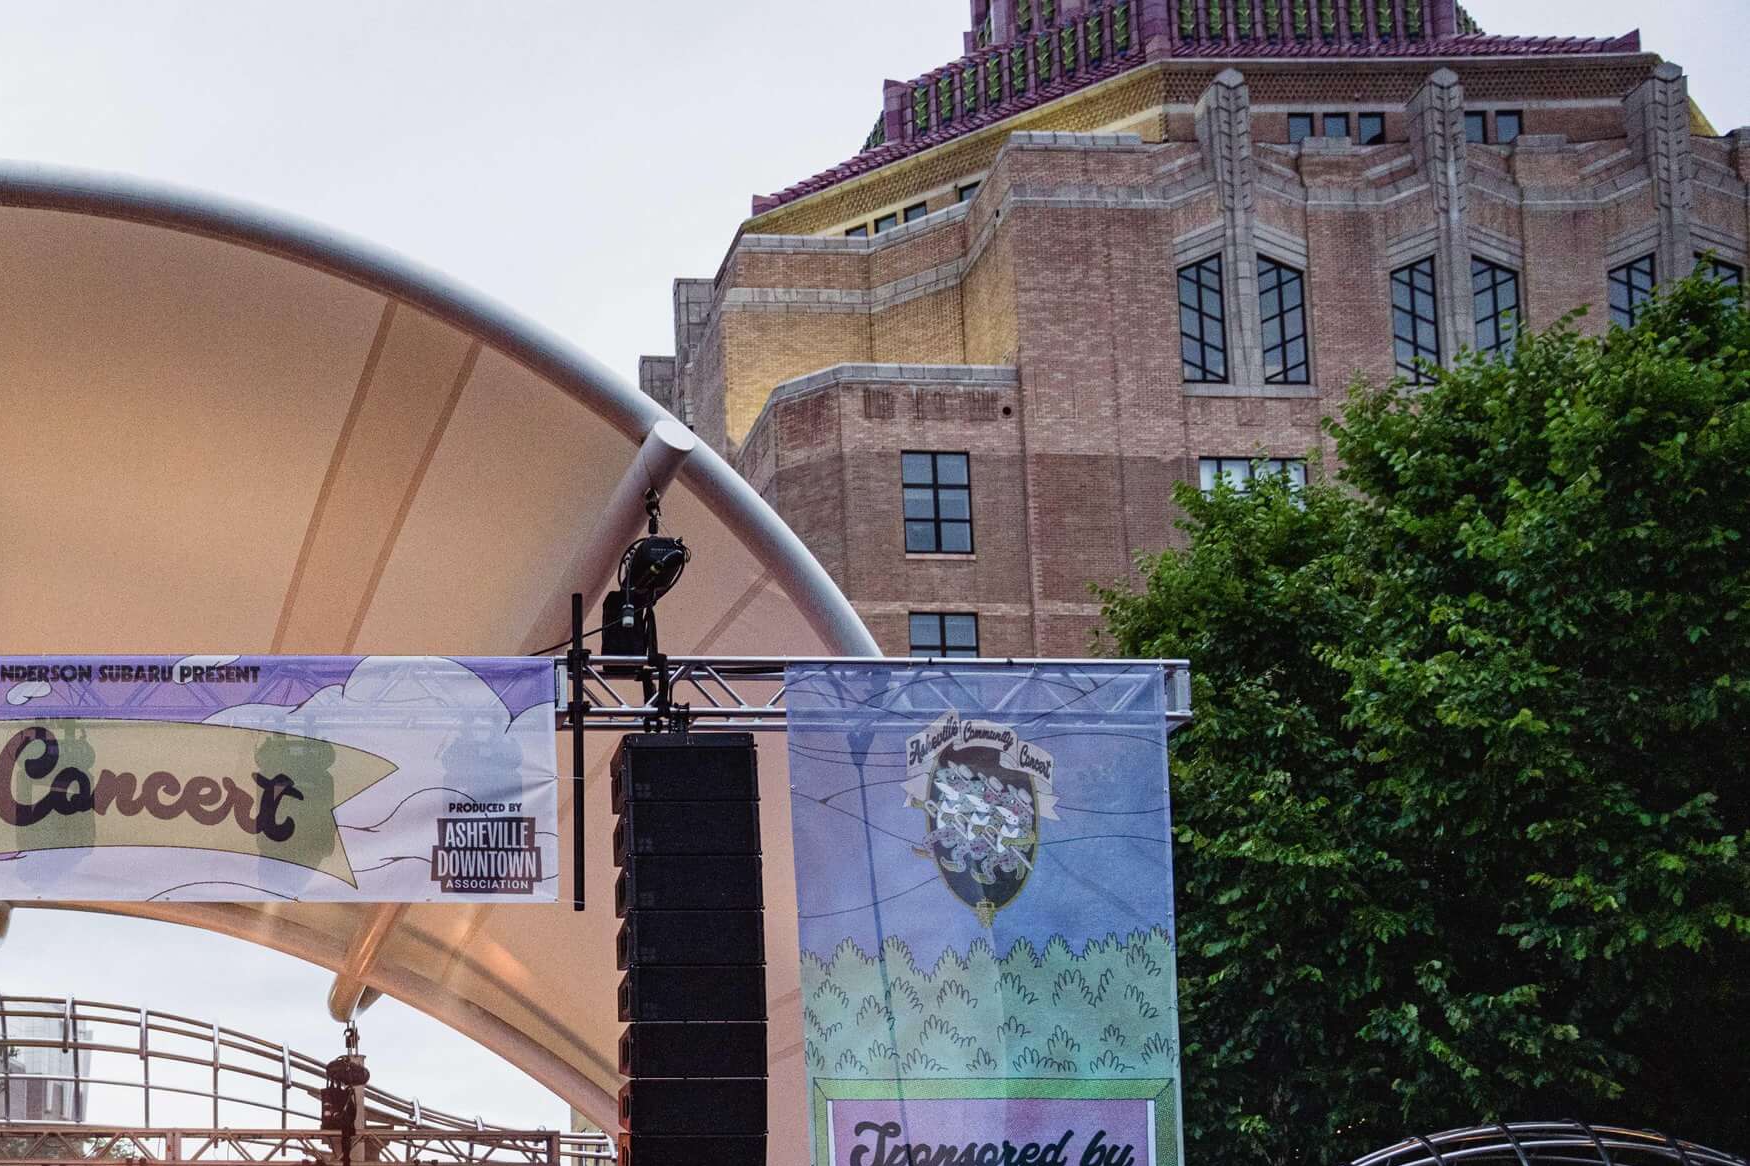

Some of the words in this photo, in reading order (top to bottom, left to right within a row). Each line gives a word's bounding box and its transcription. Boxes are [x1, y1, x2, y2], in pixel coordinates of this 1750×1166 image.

[99, 664, 173, 683] SUBARU
[180, 664, 261, 683] PRESENT
[908, 715, 959, 766] Asheville
[449, 802, 506, 813] PRODUCED
[508, 802, 523, 812] BY
[444, 821, 529, 849] ASHEVILLE
[437, 850, 537, 878] DOWNTOWN
[445, 879, 529, 889] ASSOCIATION
